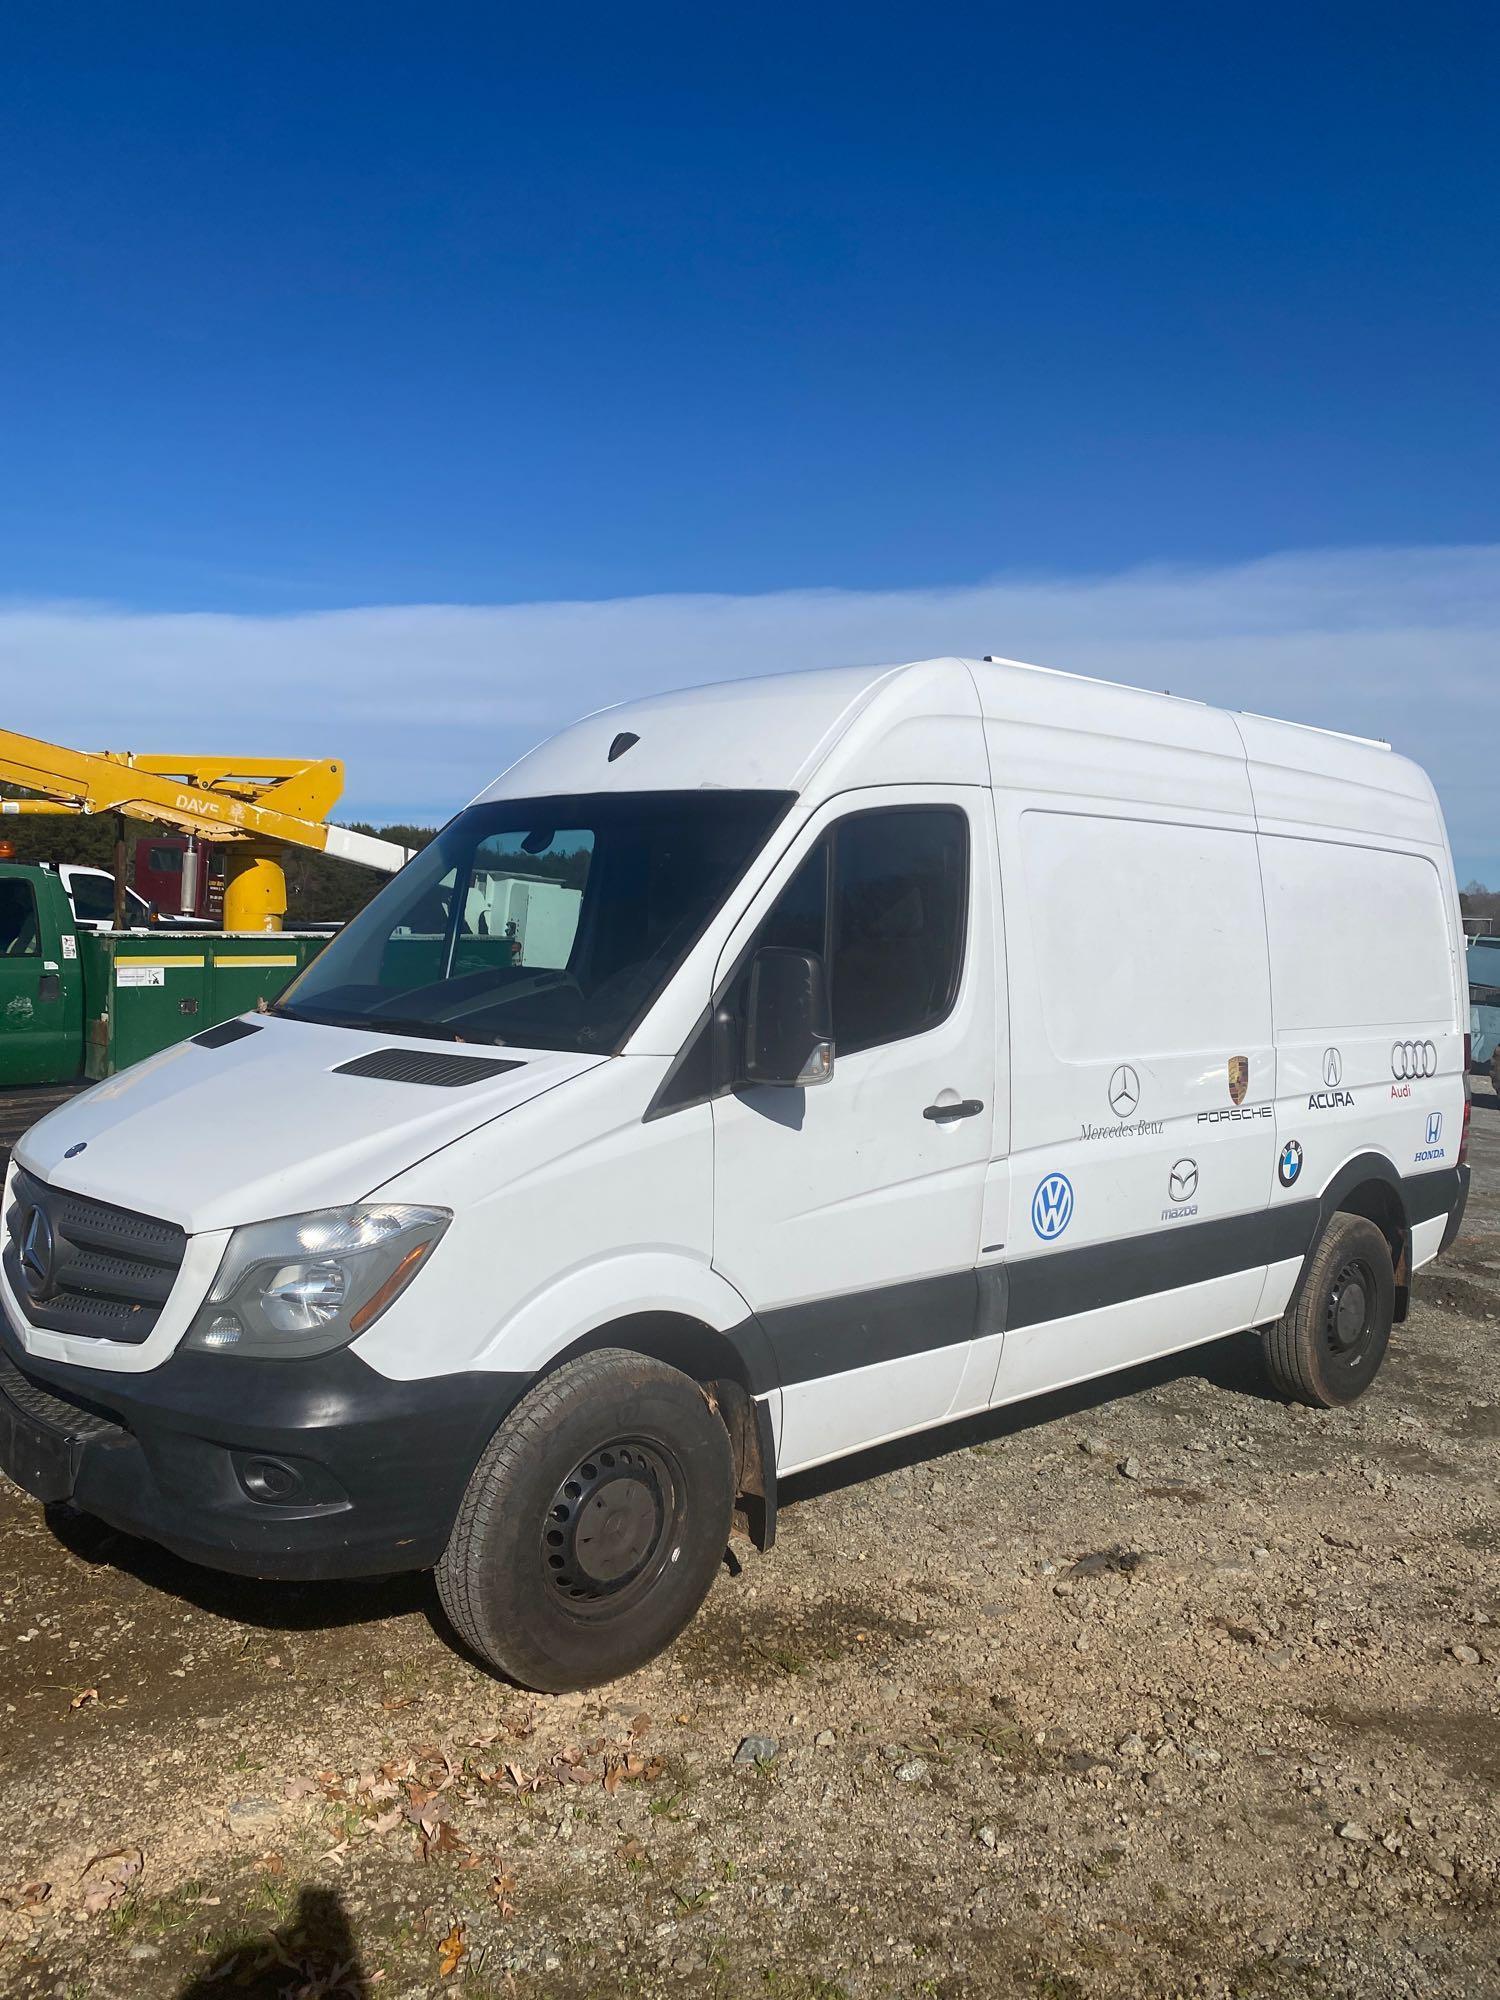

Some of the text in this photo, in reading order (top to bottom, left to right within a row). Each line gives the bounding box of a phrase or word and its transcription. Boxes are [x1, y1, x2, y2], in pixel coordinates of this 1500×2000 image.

[1308, 1091, 1355, 1110] ACURA
[1391, 1085, 1411, 1099] Audi
[1196, 1106, 1273, 1124] PORSCHE
[1079, 1120, 1164, 1141] Mercedes-Benz
[1414, 1148, 1445, 1162] HONDA
[1161, 1204, 1198, 1221] mazda
